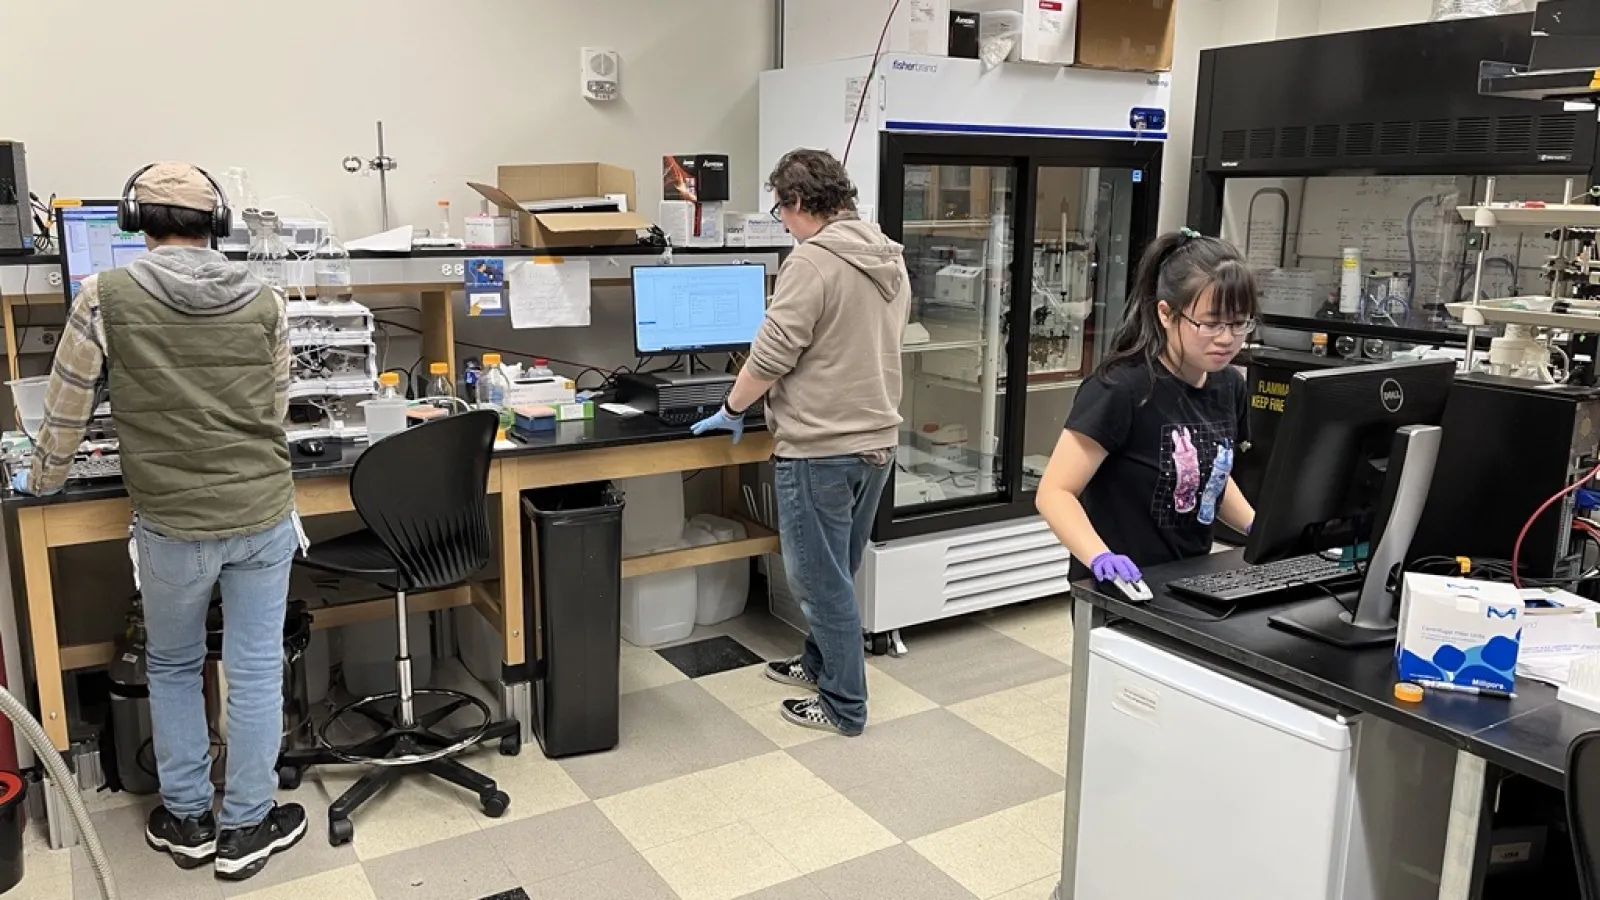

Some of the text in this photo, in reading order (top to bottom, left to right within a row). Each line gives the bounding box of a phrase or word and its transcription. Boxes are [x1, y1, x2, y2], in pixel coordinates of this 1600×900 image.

[892, 60, 938, 73] fisherbrand
[1384, 391, 1401, 401] DELL
[1251, 395, 1285, 412] KEEP FIRE
